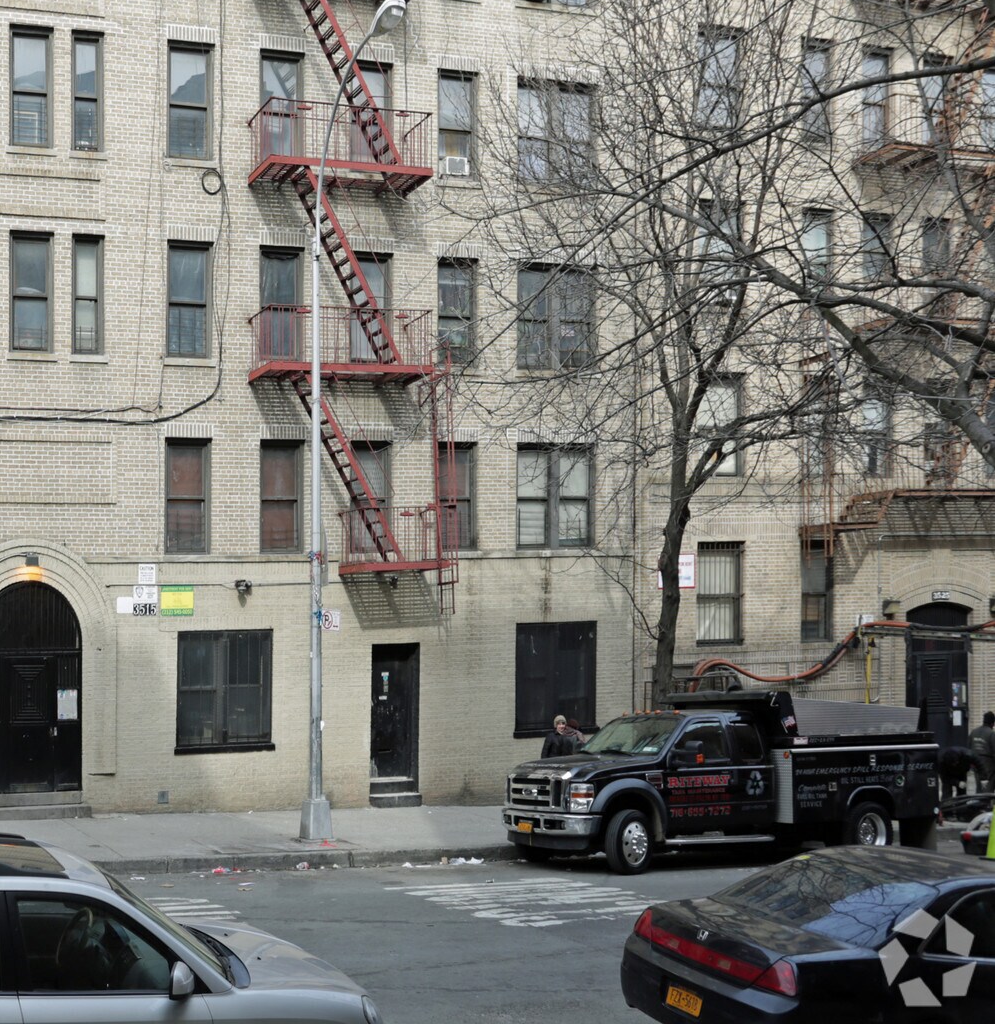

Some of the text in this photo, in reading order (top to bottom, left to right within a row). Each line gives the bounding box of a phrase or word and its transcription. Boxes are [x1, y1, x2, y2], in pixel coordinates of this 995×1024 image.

[133, 604, 156, 616] 3515
[816, 767, 852, 775] EMERGENCY
[852, 765, 870, 774] SPILL
[871, 763, 904, 772] RESPONSE
[907, 762, 935, 771] SERVICE
[667, 774, 731, 788] RITEWAY
